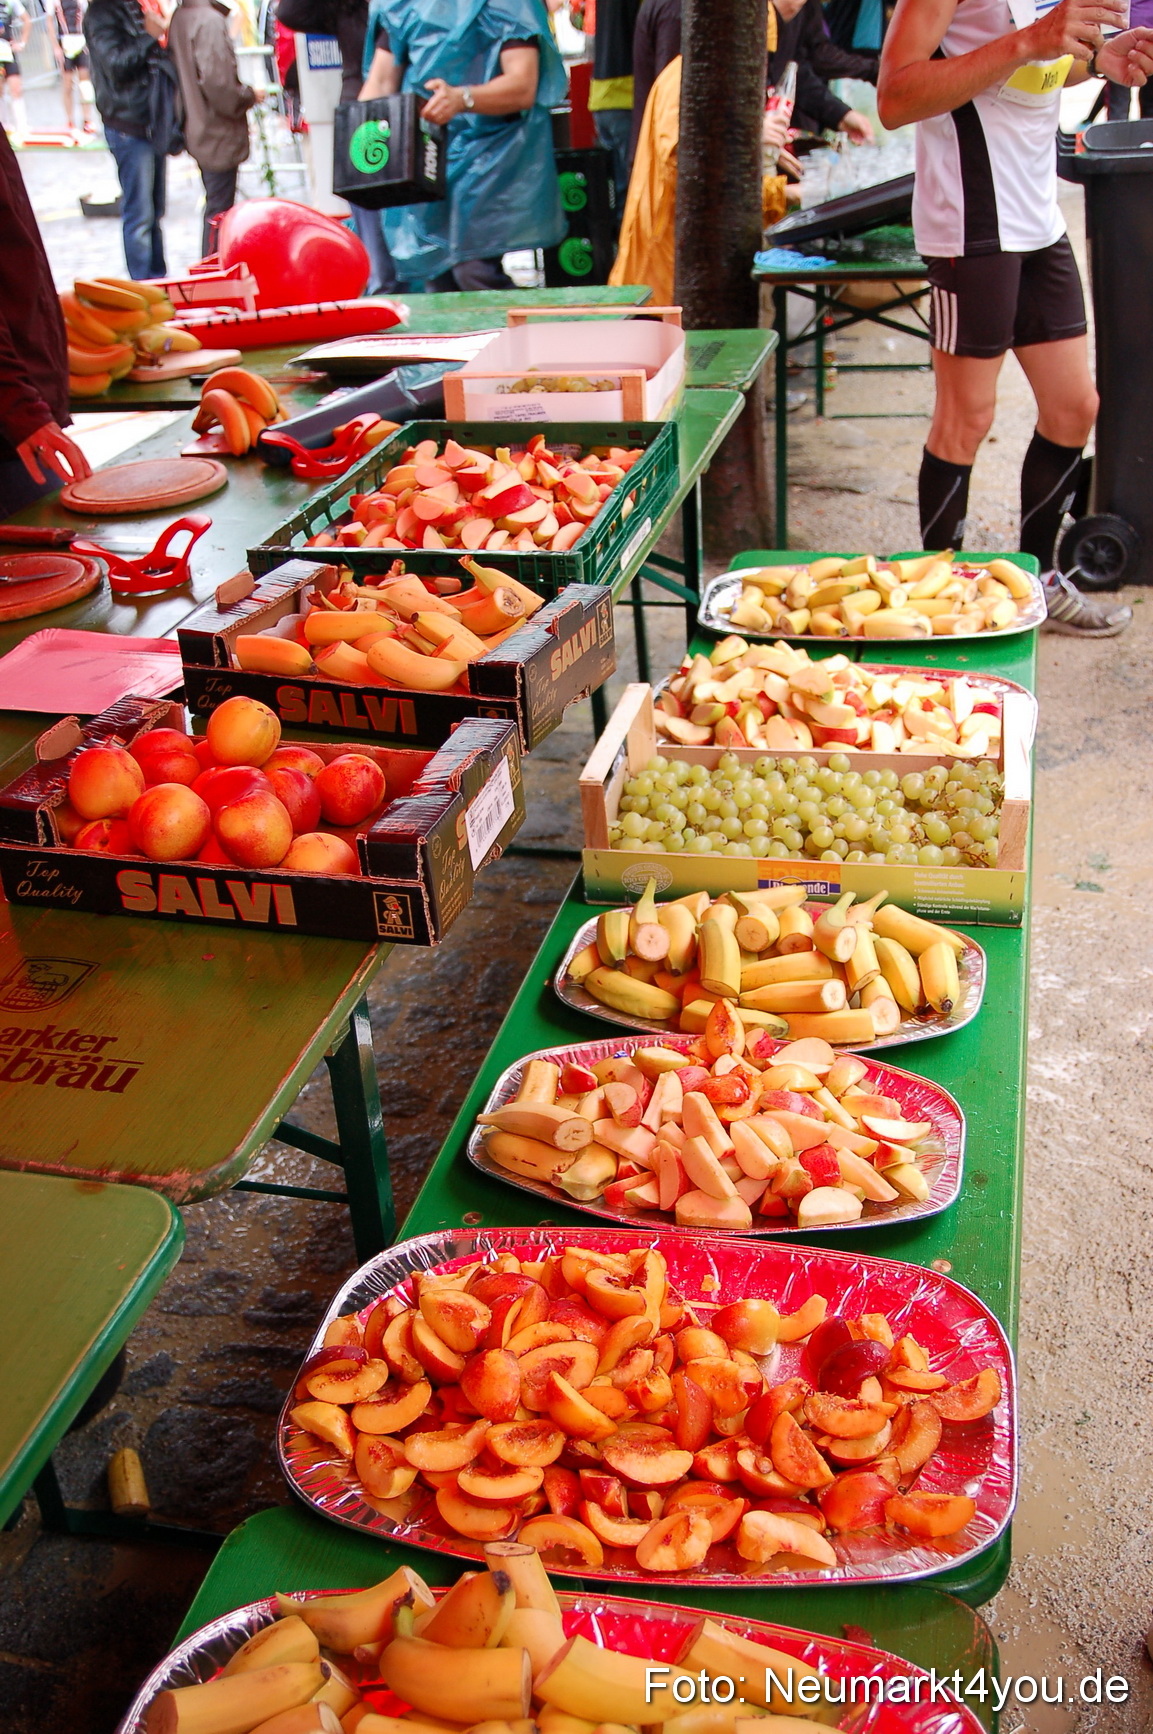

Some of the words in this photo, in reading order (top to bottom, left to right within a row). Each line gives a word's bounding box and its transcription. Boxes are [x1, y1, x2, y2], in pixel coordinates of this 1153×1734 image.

[550, 616, 597, 682] SALVI
[205, 677, 232, 696] Top
[276, 685, 418, 736] SALVI
[26, 860, 60, 881] Top
[759, 866, 840, 884] EDEKA
[16, 879, 84, 905] Quality
[116, 869, 298, 926] SALVI
[379, 924, 412, 937] SALVI
[11, 988, 47, 1000] 1628
[0, 1047, 140, 1094] bräu
